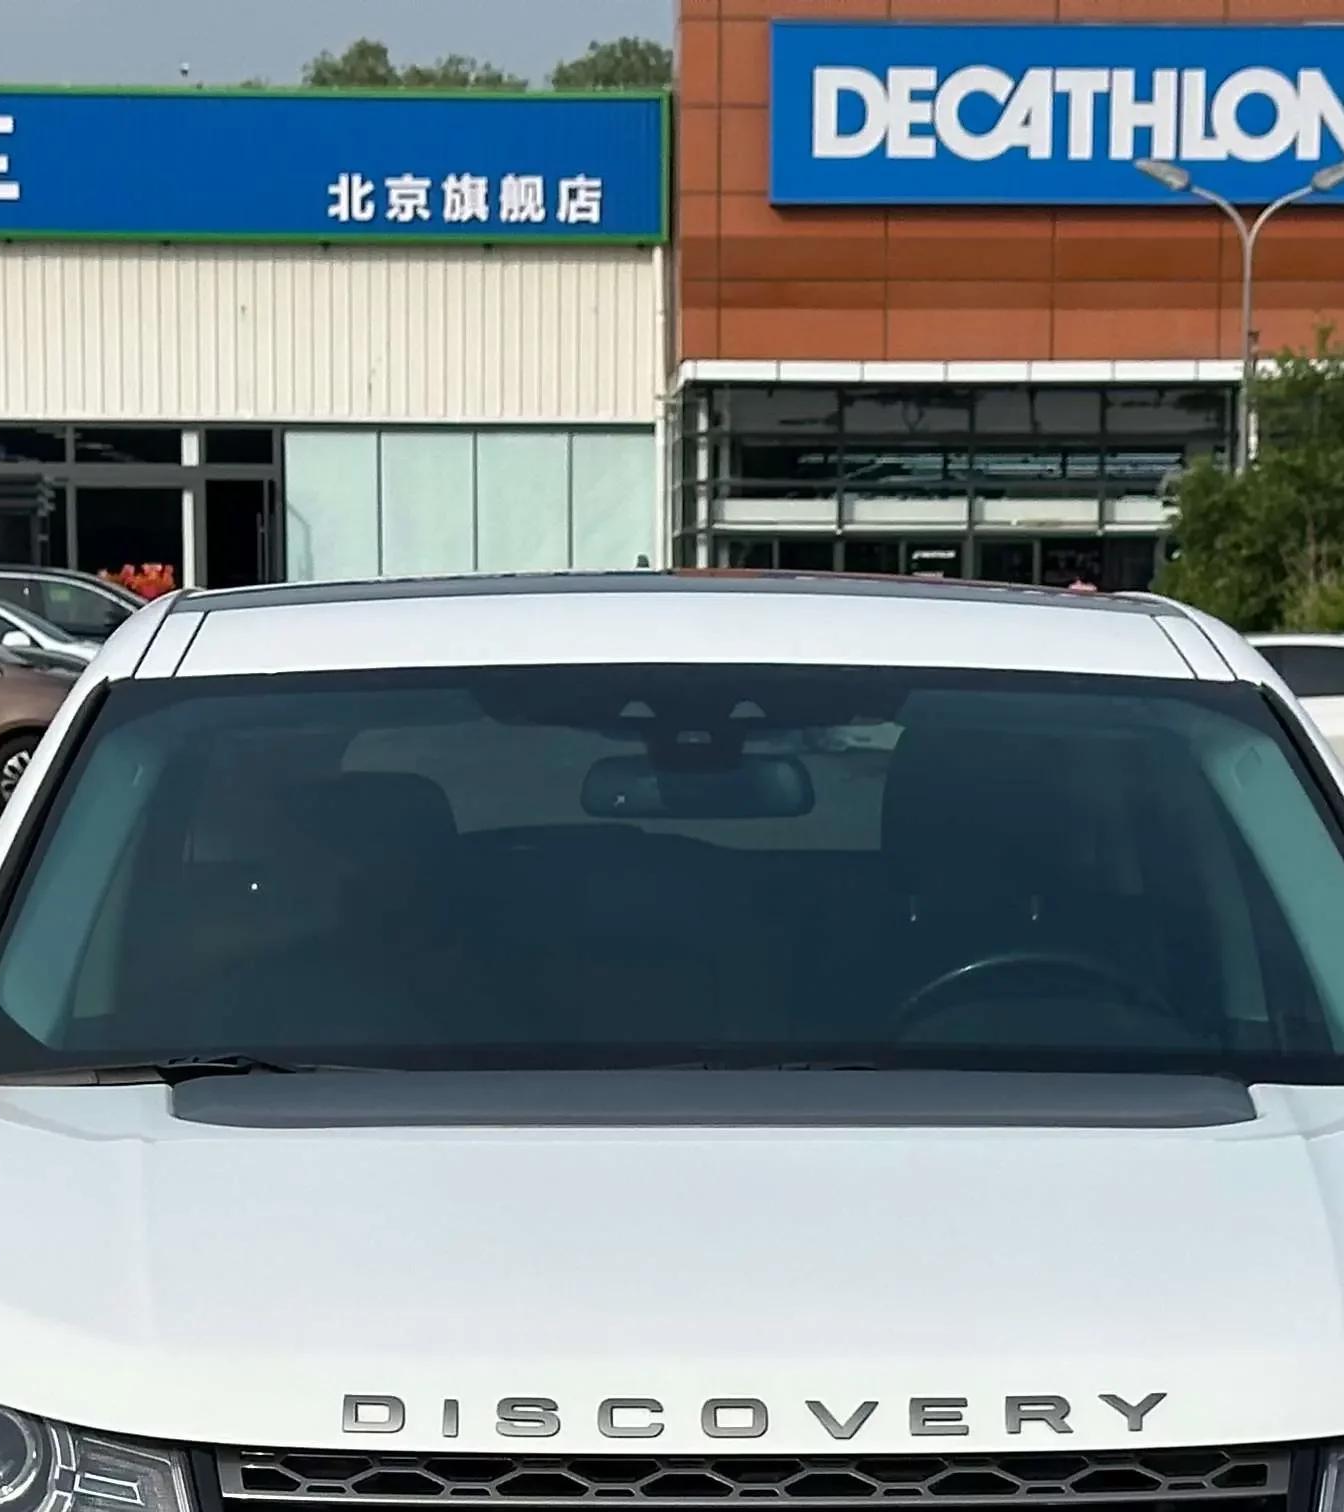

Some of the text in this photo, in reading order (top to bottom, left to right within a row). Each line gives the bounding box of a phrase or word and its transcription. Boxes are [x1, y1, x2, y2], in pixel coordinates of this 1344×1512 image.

[327, 173, 603, 223] 北京旗舰店
[342, 1391, 1169, 1440] DISCOVERY
